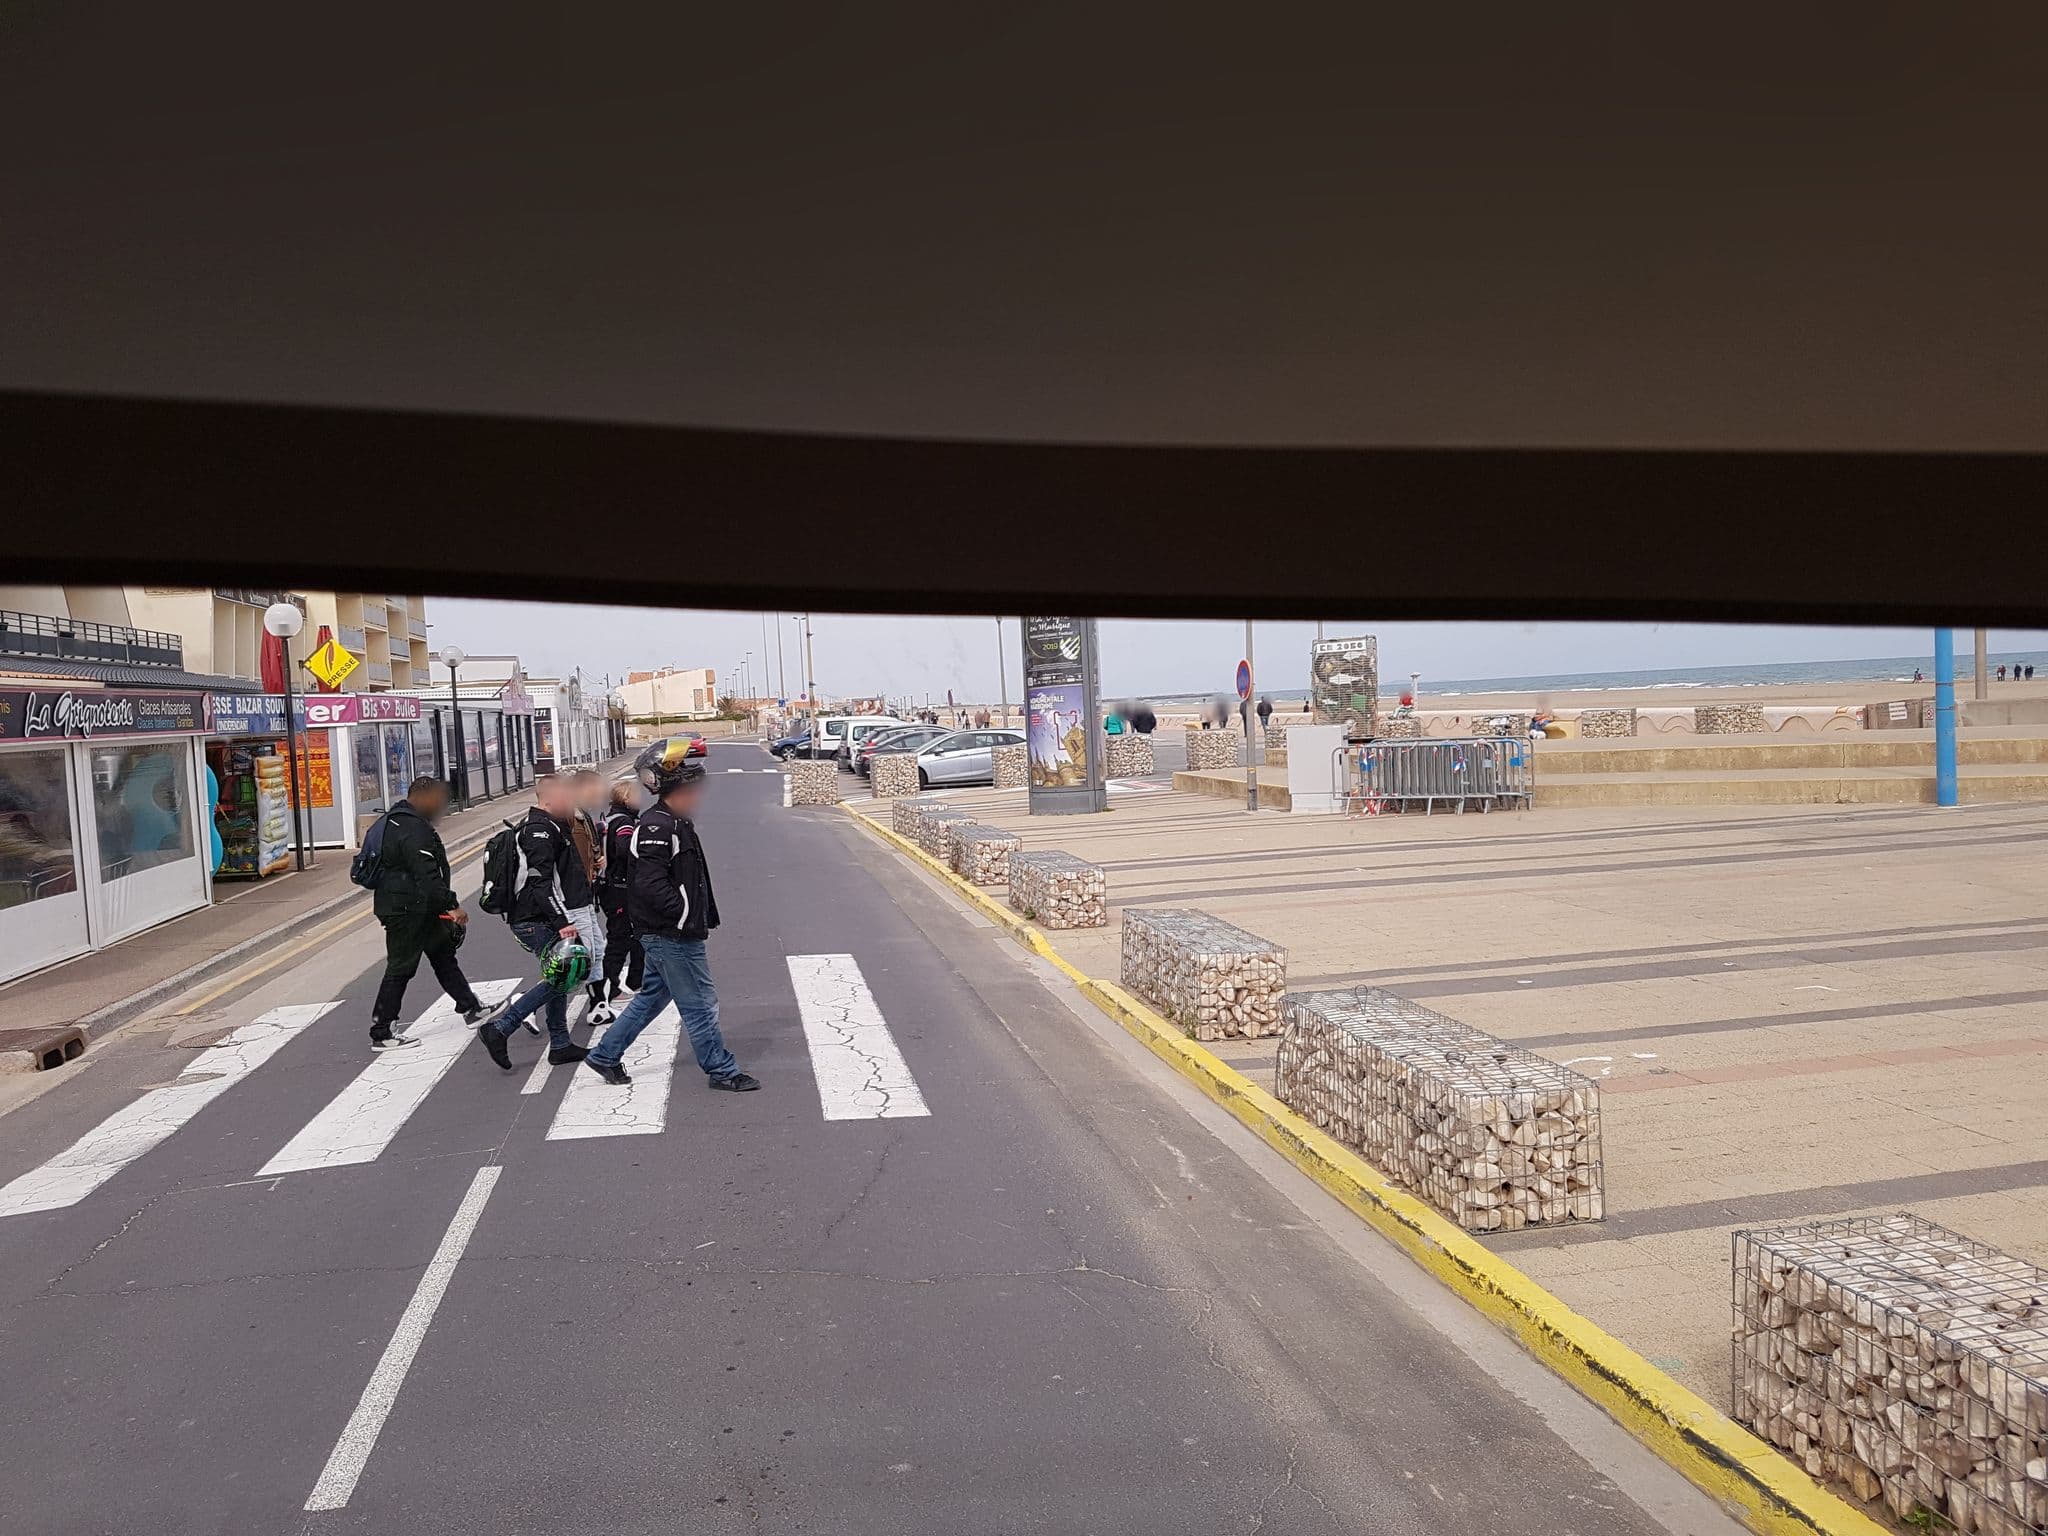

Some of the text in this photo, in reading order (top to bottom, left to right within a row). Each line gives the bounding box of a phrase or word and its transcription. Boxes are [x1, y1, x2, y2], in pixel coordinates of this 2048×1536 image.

[1042, 643, 1058, 651] 2019
[327, 657, 356, 687] PRESSE
[25, 691, 134, 738] La Grignoterie
[138, 699, 192, 715] Glaces Artisanales
[235, 697, 262, 715] BAZAR
[361, 699, 417, 718] Bis Bulle
